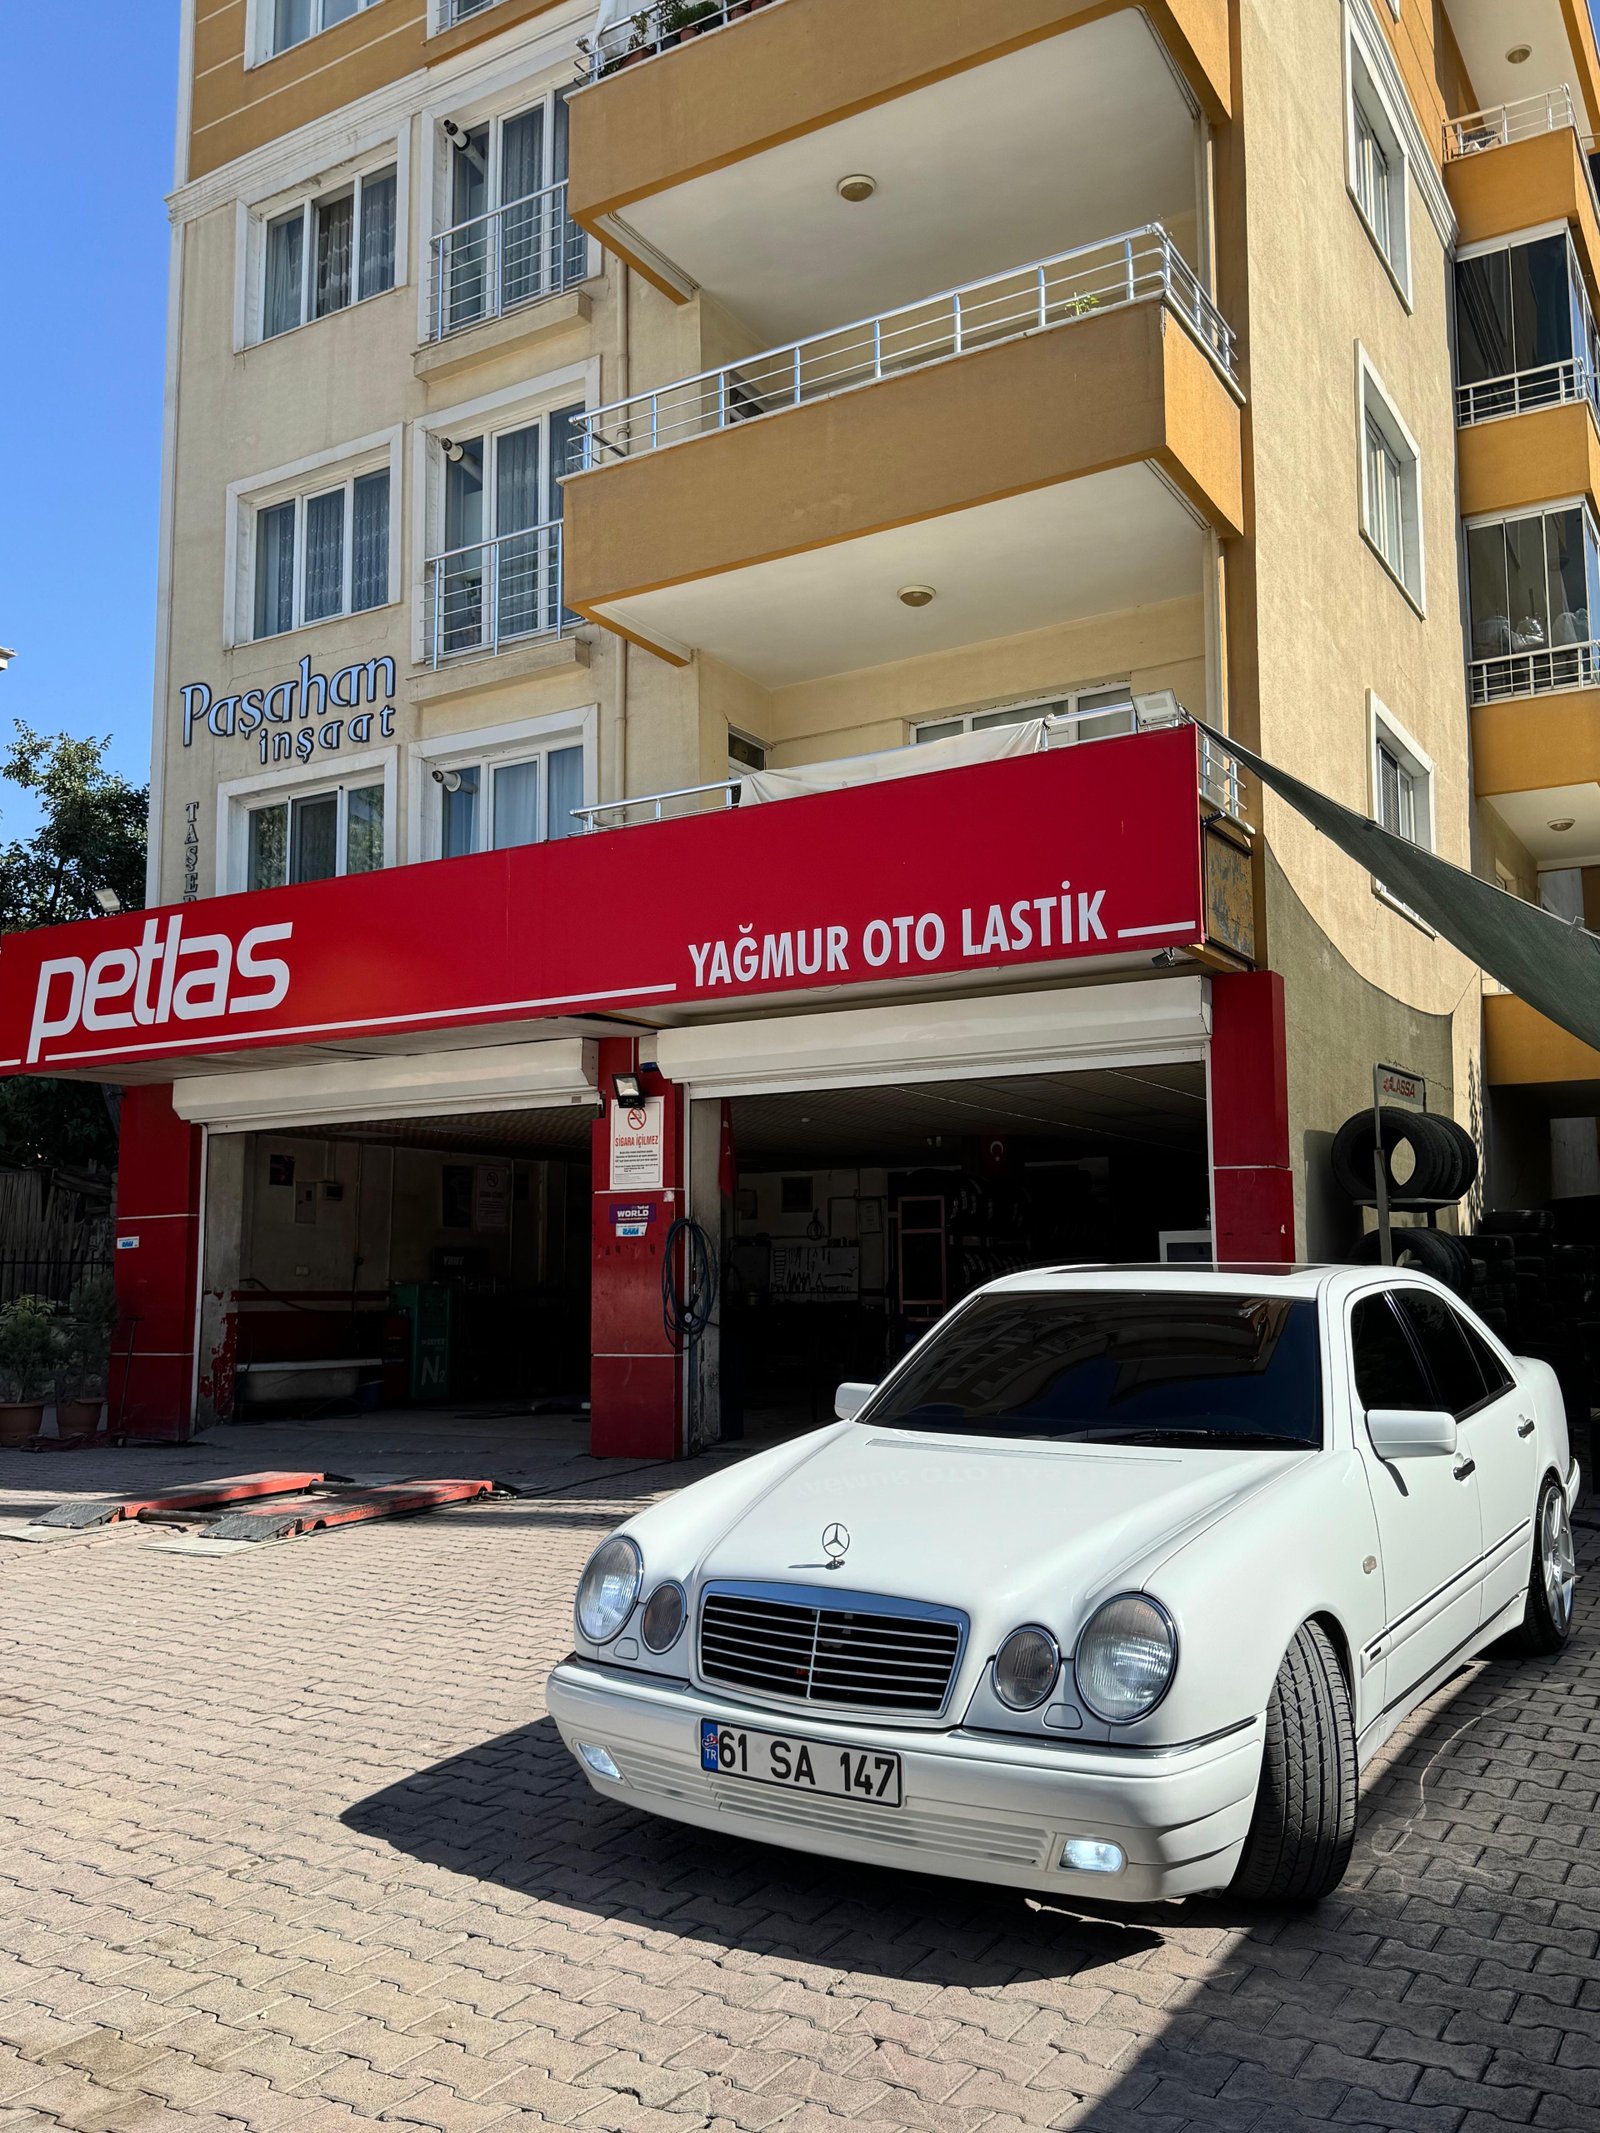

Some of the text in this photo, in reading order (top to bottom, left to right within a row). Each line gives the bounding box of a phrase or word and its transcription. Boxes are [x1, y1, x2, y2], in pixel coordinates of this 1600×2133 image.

[180, 654, 396, 747] Paşahan
[259, 704, 395, 764] inşaat
[688, 880, 1108, 987] YAĞMUR OTO LASTİK
[26, 913, 294, 1064] petlas
[616, 1209, 649, 1218] WORLD
[705, 1730, 895, 1797] TR 61 SA 147
